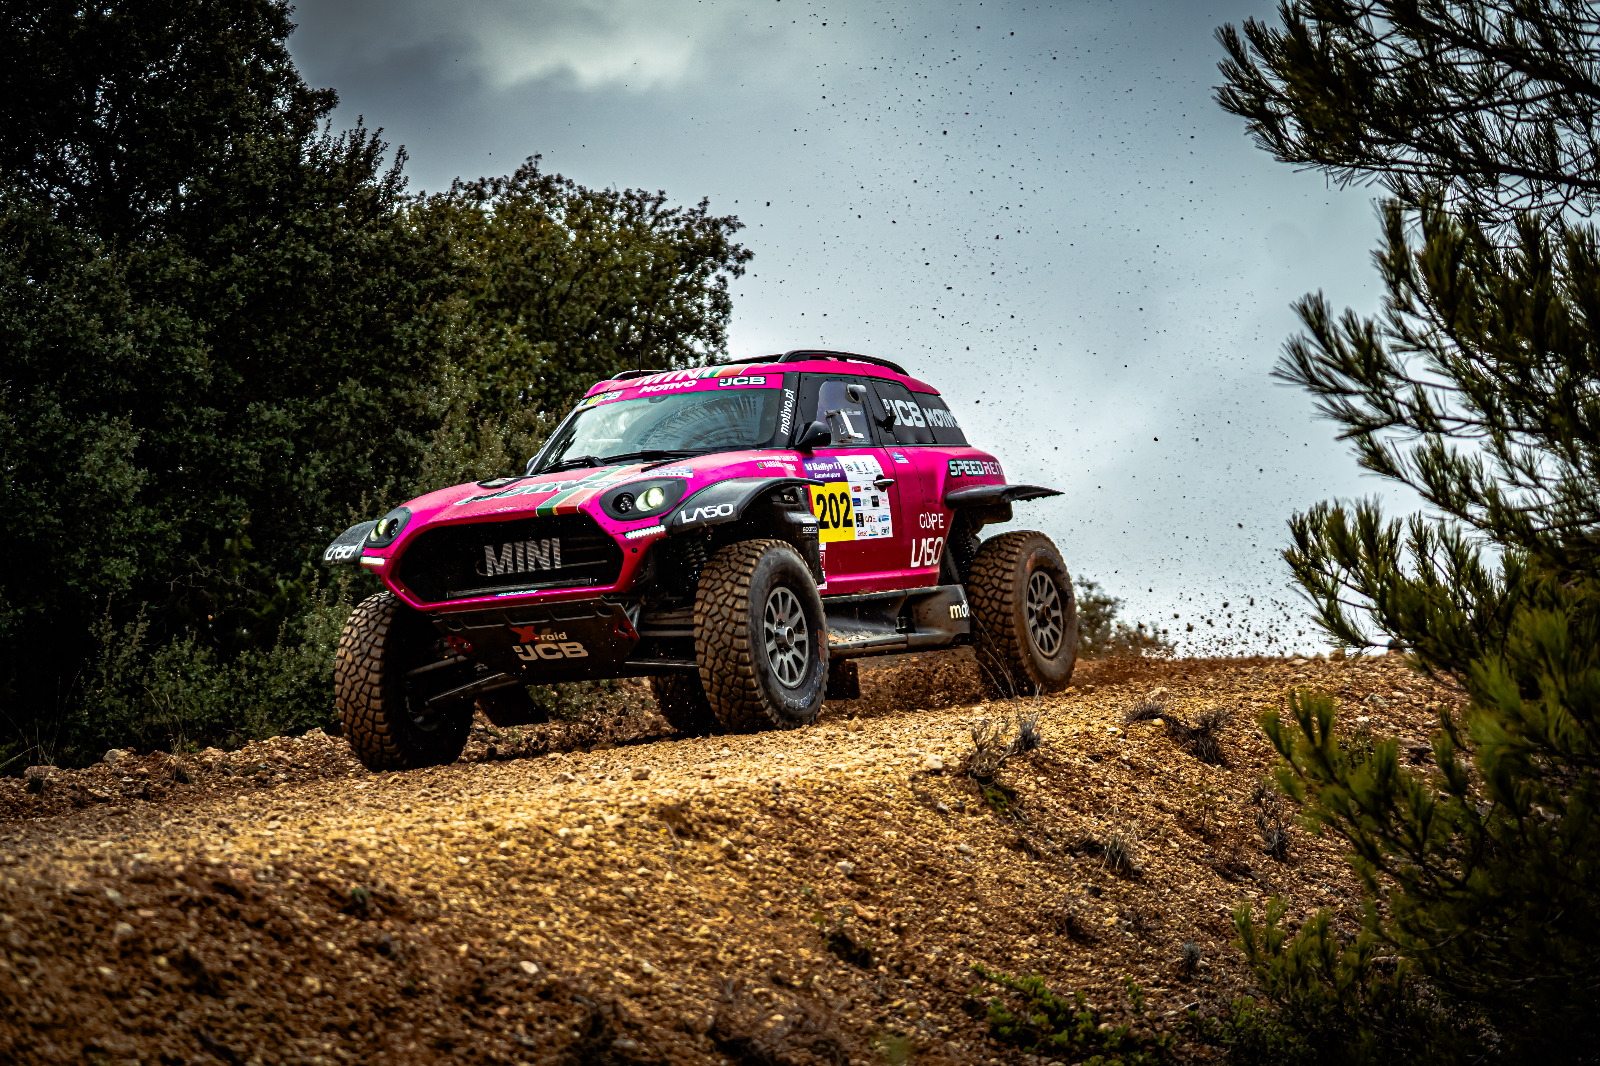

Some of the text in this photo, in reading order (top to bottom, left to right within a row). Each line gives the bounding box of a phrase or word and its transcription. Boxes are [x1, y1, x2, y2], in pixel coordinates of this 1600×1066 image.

[634, 365, 712, 387] MINI
[638, 379, 697, 394] MOTIVO
[720, 376, 766, 387] JCB
[780, 388, 795, 436] motivo.pt
[680, 503, 734, 524] LASO
[816, 492, 854, 530] 202
[484, 538, 562, 577] MINI
[910, 537, 944, 568] LASO
[512, 641, 589, 661] JCB
